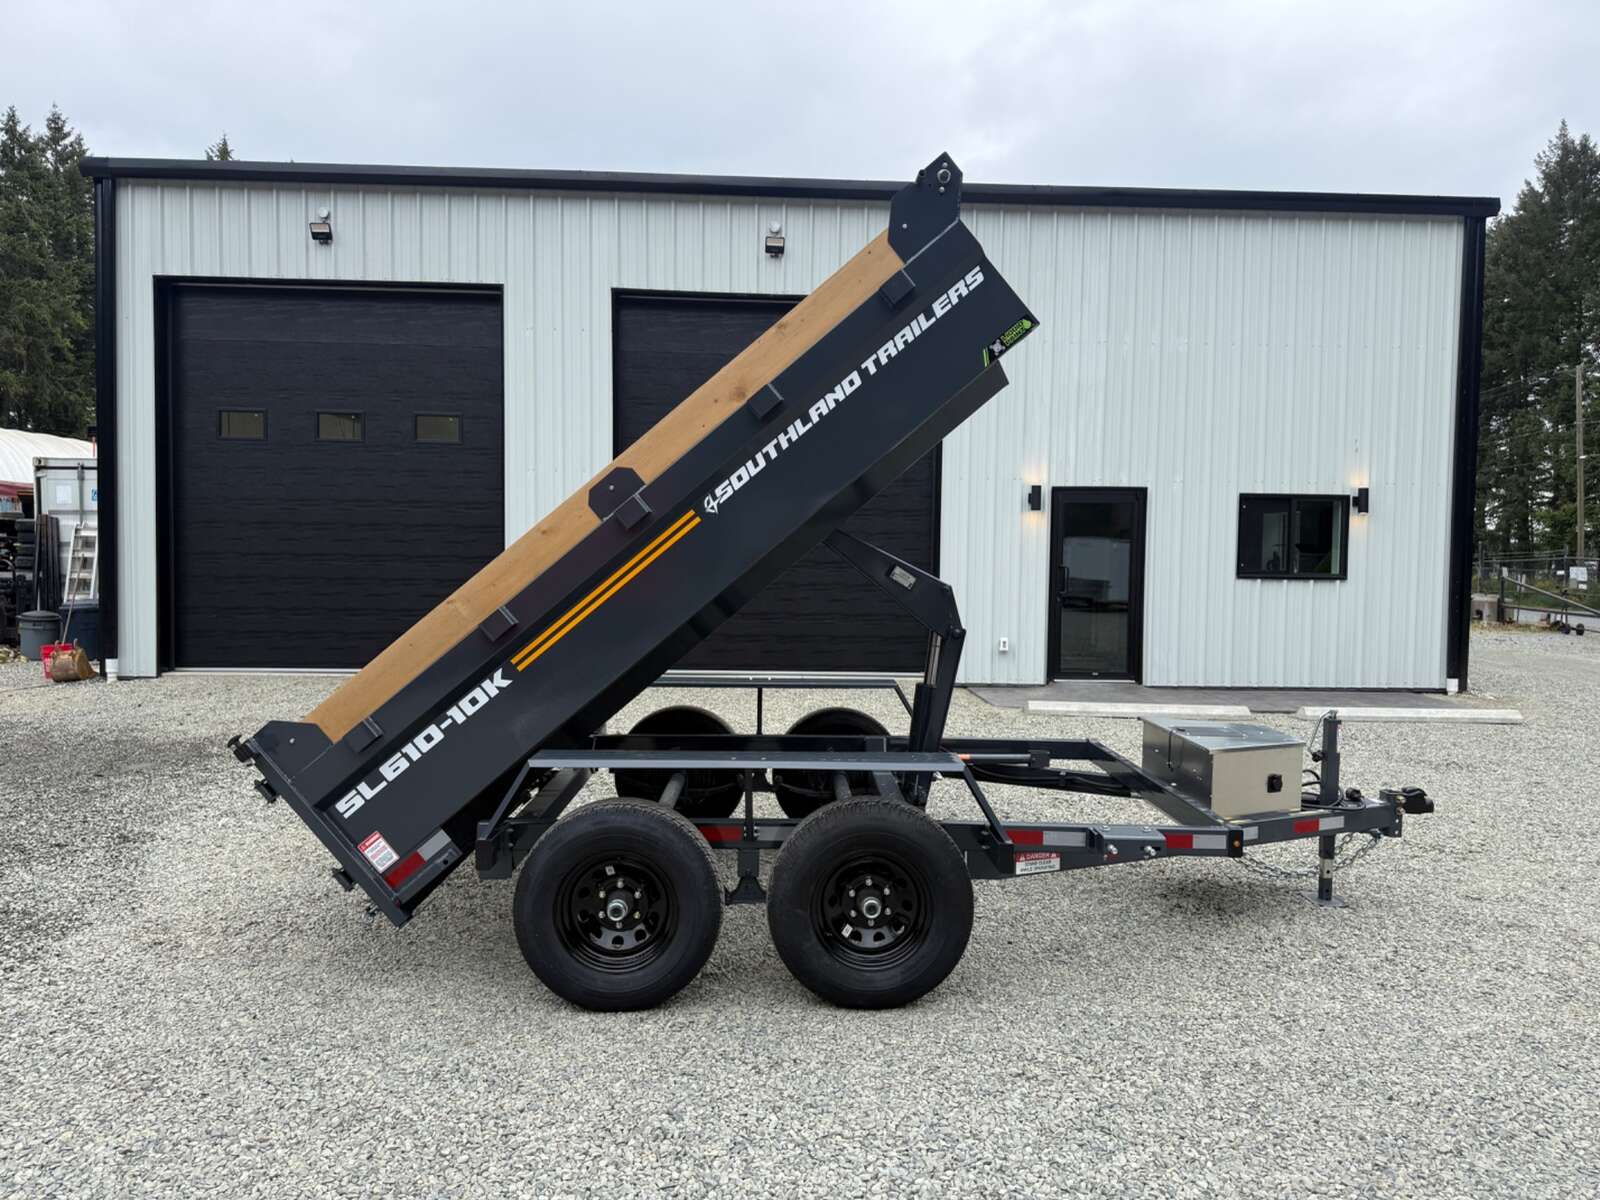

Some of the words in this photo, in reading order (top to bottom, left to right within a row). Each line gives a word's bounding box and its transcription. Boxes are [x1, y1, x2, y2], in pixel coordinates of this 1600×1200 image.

[715, 370, 862, 504] SOUTHLAND
[861, 265, 985, 376] TRAILERS
[335, 667, 513, 819] SL610-10K
